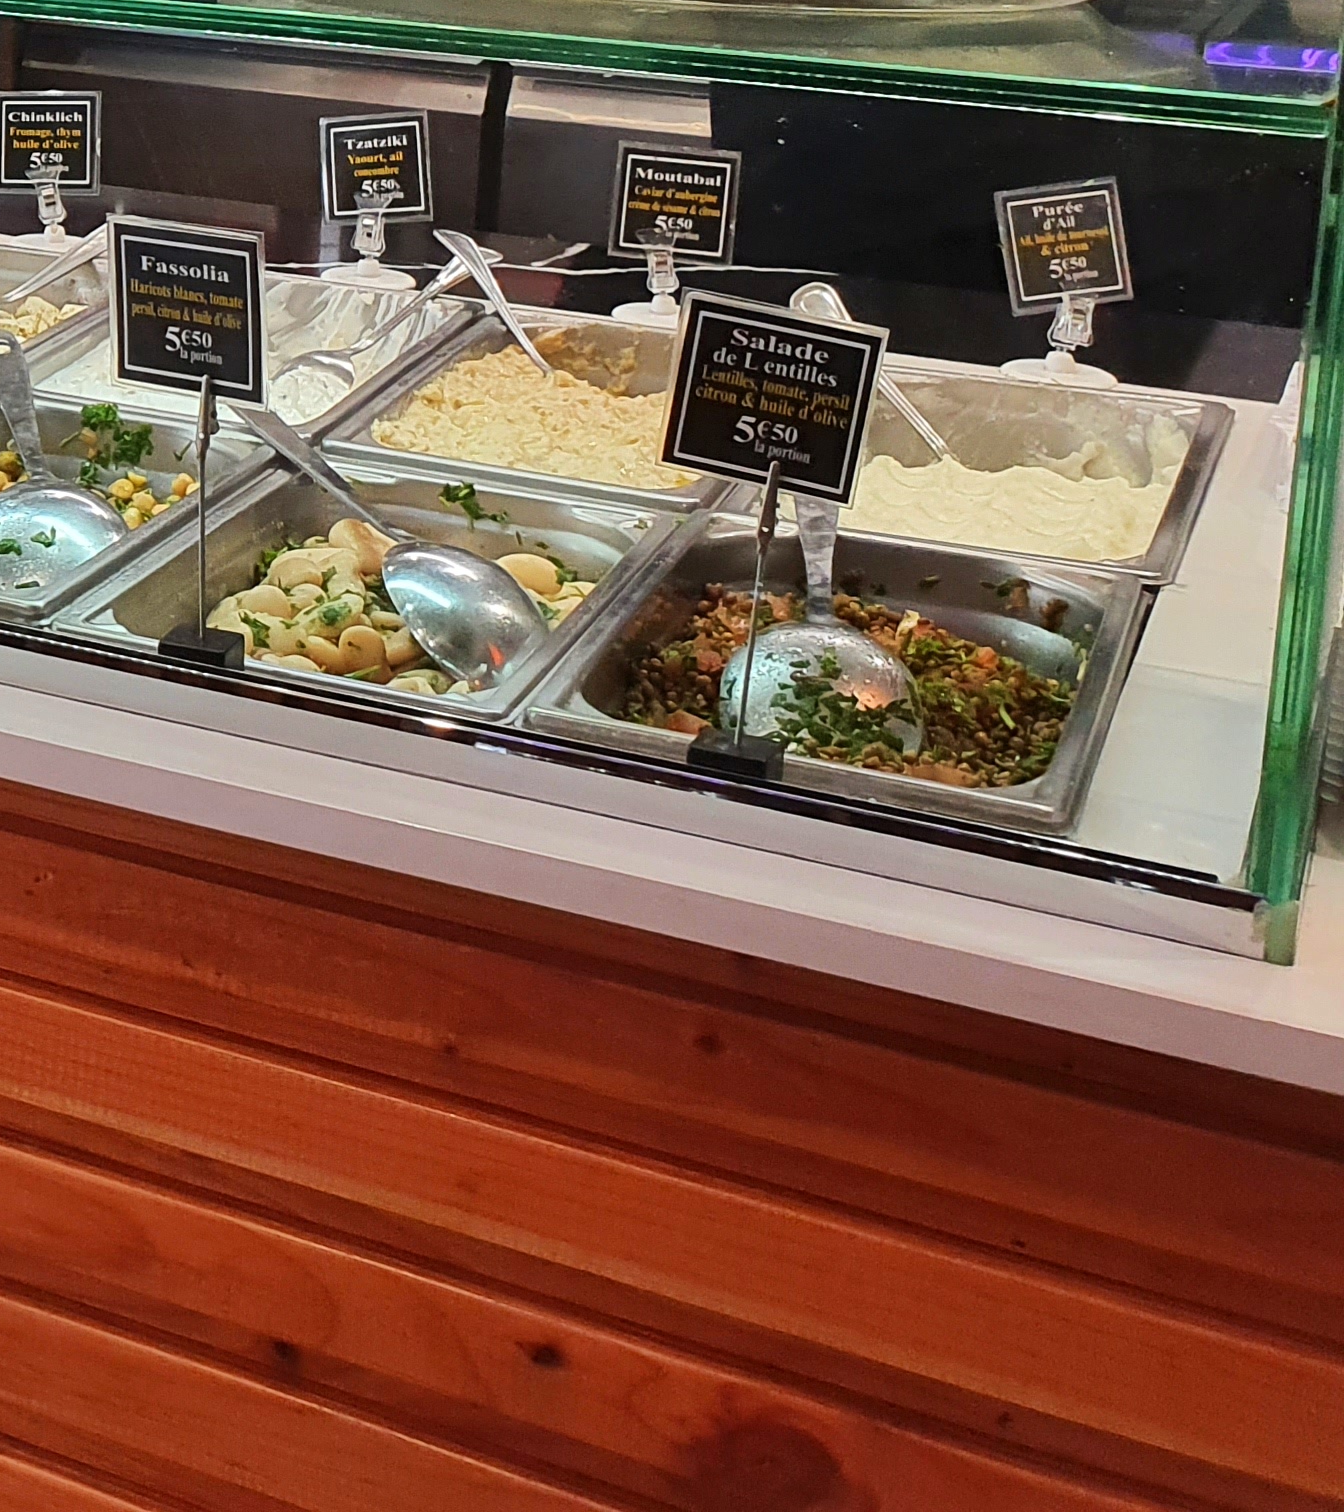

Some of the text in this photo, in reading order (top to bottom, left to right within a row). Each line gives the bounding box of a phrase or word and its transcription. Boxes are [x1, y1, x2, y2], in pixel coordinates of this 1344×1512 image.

[8, 111, 83, 123] Chinklich
[56, 127, 81, 138] thym
[13, 139, 80, 149] huile d'olive
[344, 134, 408, 150] Tzatziki
[29, 152, 63, 168] 5€50
[347, 151, 403, 165] Yaourt, ail
[635, 167, 721, 187] Moutabal
[361, 179, 395, 197] 5€50
[1032, 201, 1084, 218] Purée
[654, 215, 693, 234] 5€50
[1043, 215, 1075, 231] d'Ail
[1040, 242, 1089, 256] & citron
[141, 255, 230, 283] Fassolia
[1049, 256, 1087, 279] 5€50
[130, 278, 171, 298] Haricots
[209, 293, 244, 309] tomate
[183, 307, 190, 321] &
[165, 326, 212, 352] 5€50
[730, 328, 829, 364] Salade
[180, 347, 223, 365] la portion
[713, 347, 737, 364] de
[702, 365, 850, 411] Lentilles, tomate, persil
[696, 384, 736, 405] citron
[742, 392, 754, 408] &
[759, 396, 795, 417] huile
[733, 415, 798, 444] 5€50
[754, 439, 810, 464] la portion
